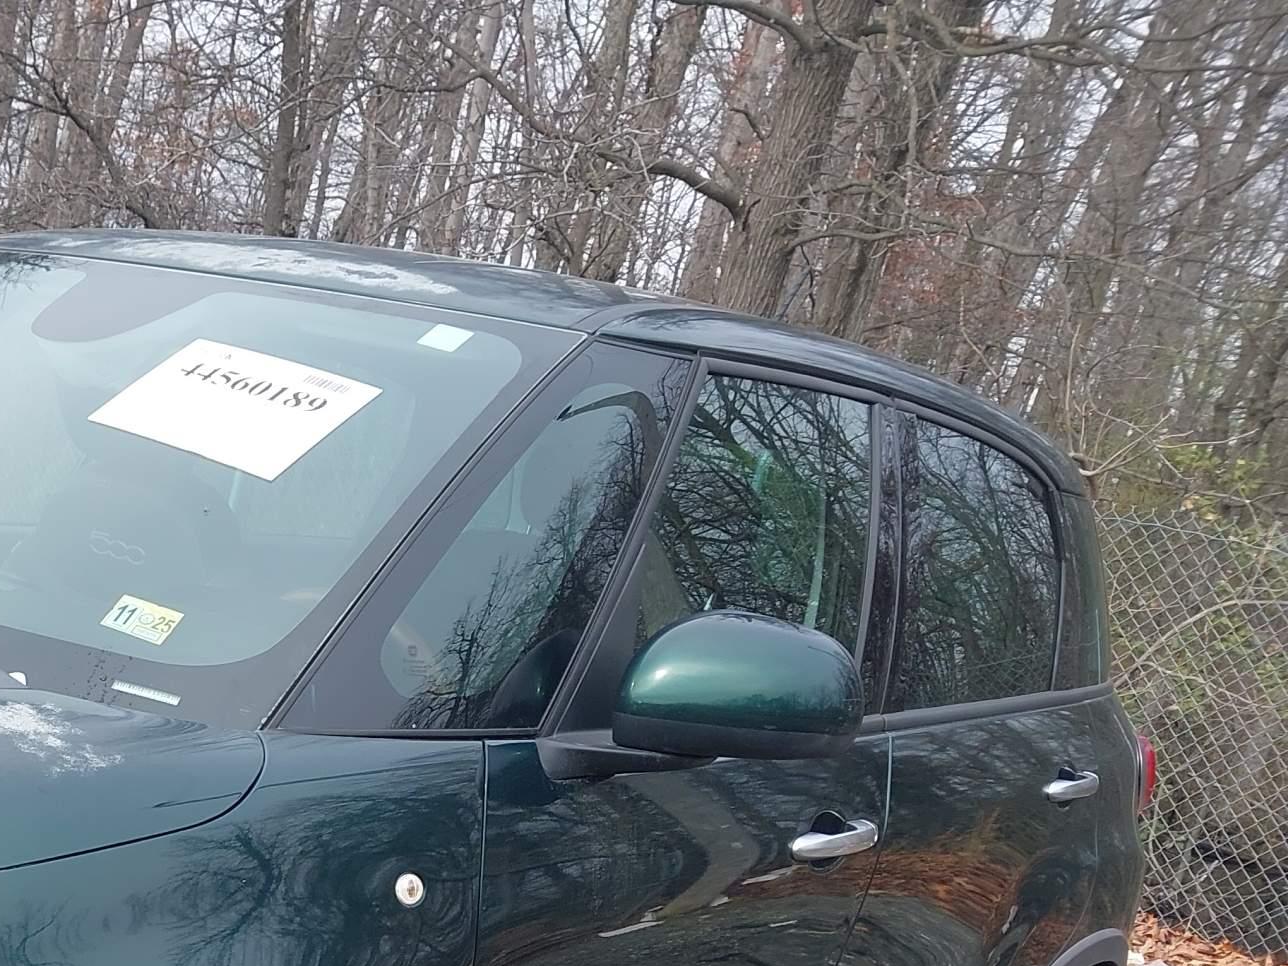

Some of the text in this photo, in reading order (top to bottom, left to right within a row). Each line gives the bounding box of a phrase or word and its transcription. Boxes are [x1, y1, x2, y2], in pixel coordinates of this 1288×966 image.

[180, 363, 328, 412] 44560189
[113, 604, 138, 625] 11
[151, 616, 176, 634] 25
